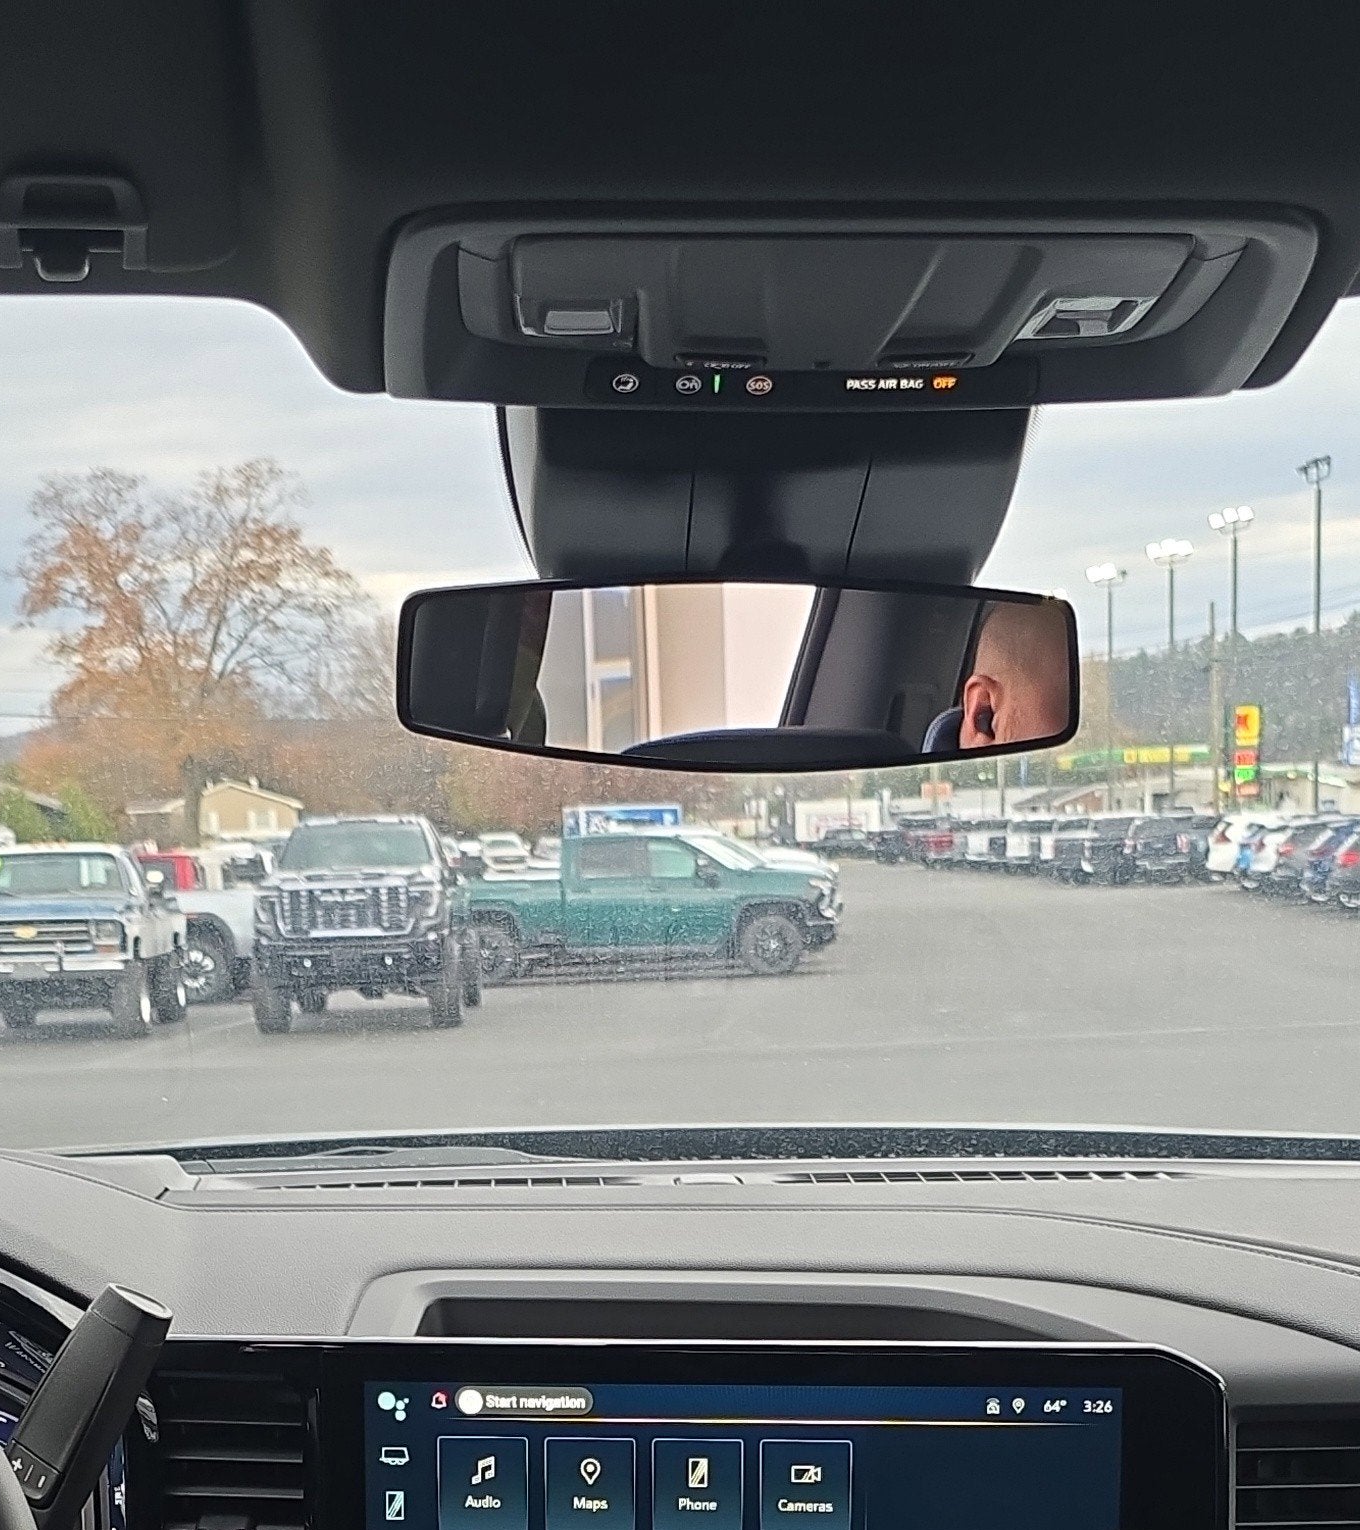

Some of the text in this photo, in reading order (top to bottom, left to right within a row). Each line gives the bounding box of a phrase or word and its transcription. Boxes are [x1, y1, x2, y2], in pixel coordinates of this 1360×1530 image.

[748, 379, 770, 391] SOS
[846, 377, 957, 390] PASS AIR BAG OFF
[485, 1394, 586, 1412] Start navigation
[1043, 1399, 1113, 1414] 64° 3:26
[464, 1495, 501, 1510] Audio
[573, 1497, 608, 1513] Maps
[678, 1498, 717, 1512] Phone
[777, 1499, 834, 1513] Cameras
